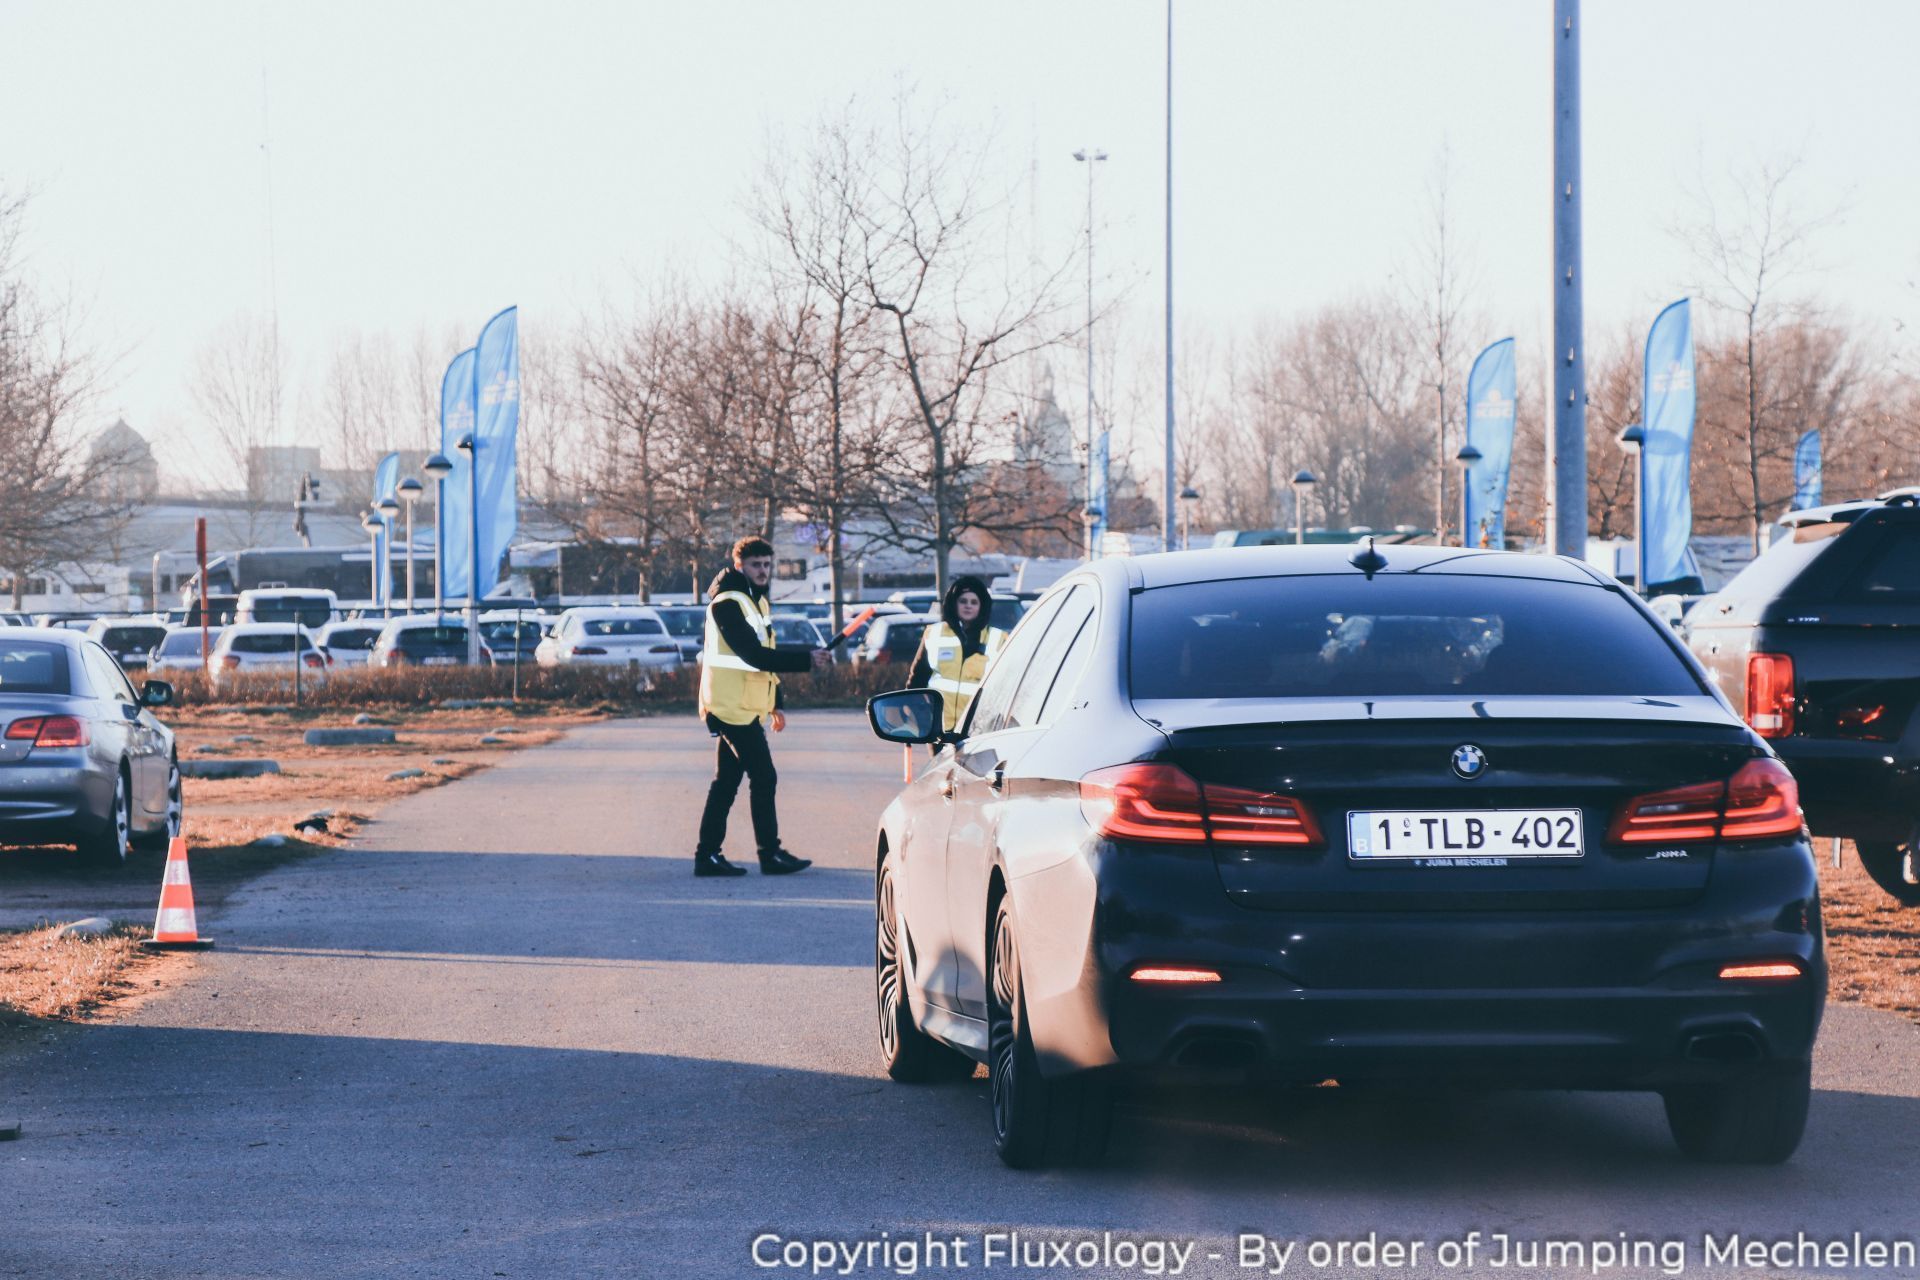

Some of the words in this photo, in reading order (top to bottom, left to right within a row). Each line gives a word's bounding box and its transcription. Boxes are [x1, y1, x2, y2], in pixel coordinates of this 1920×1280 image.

[1356, 838, 1369, 853] B
[1425, 858, 1454, 867] JUMA
[1454, 857, 1508, 867] MECHELEN
